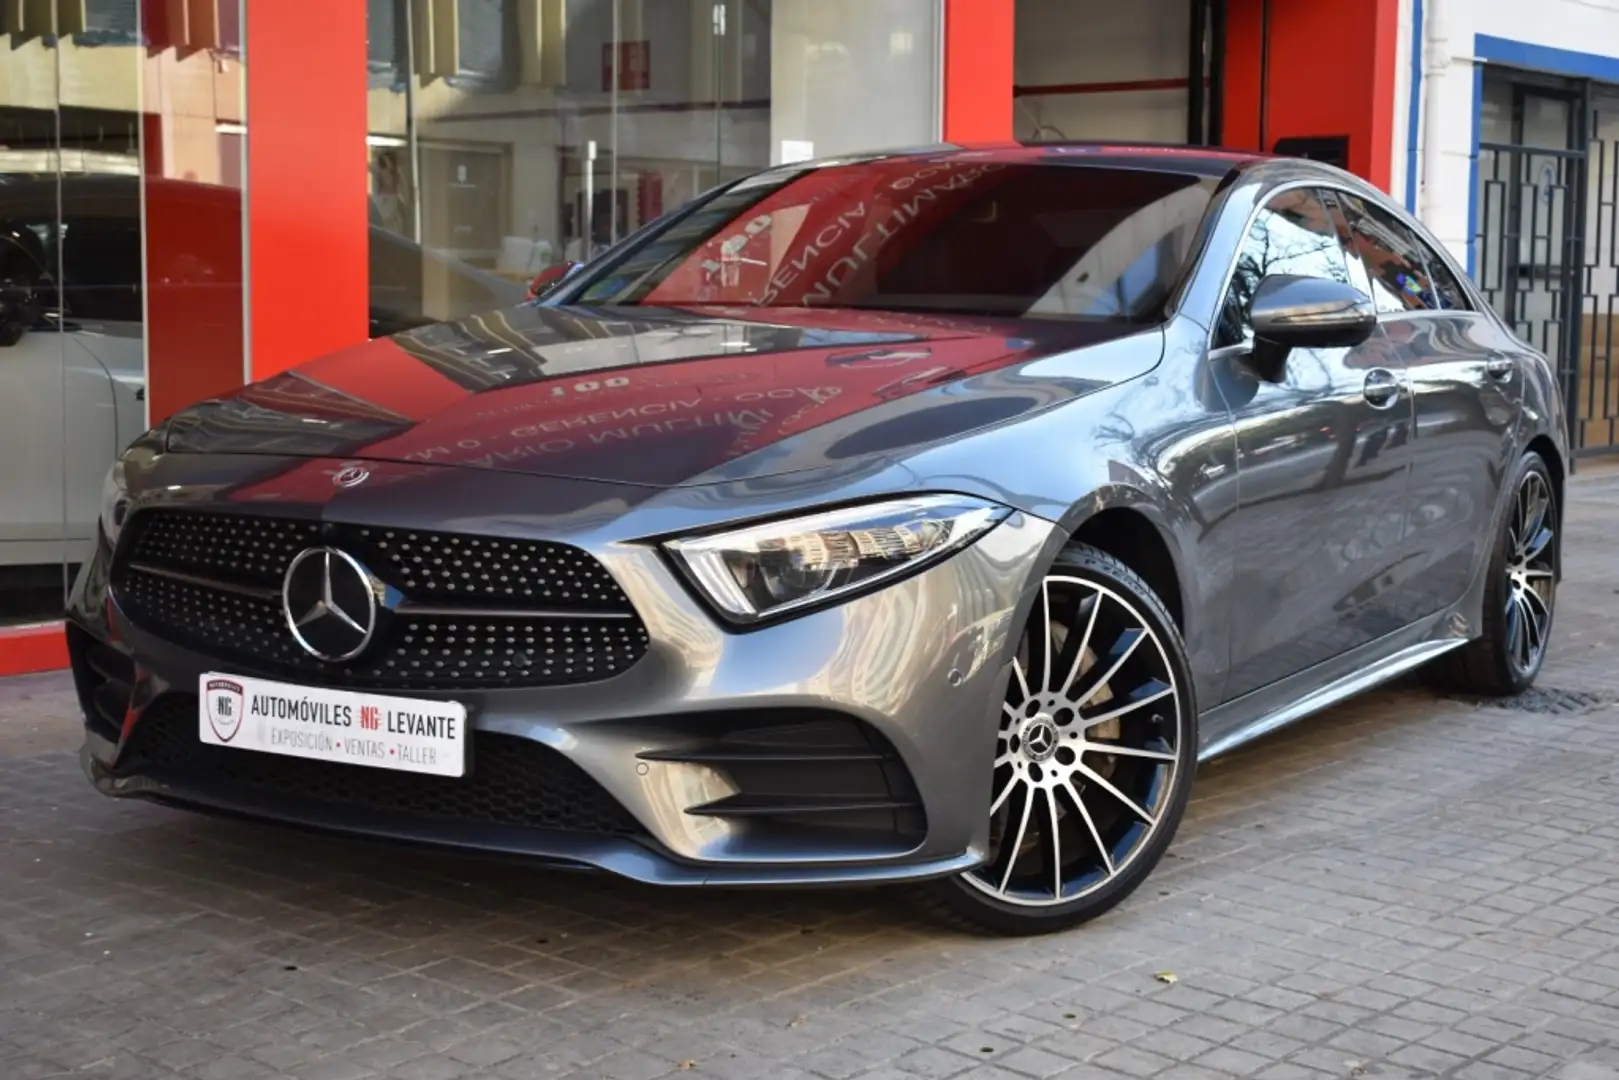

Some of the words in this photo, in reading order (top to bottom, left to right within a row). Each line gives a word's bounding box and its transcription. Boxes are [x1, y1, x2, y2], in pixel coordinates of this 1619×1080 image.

[217, 695, 233, 717] NG
[251, 695, 352, 727] AUTOMÓVILES
[359, 705, 381, 731] NG
[387, 711, 456, 739] LEVANTE
[271, 727, 333, 752] EXPOSICIÓN
[344, 743, 385, 759] VENTAS
[397, 743, 437, 765] TALLER
